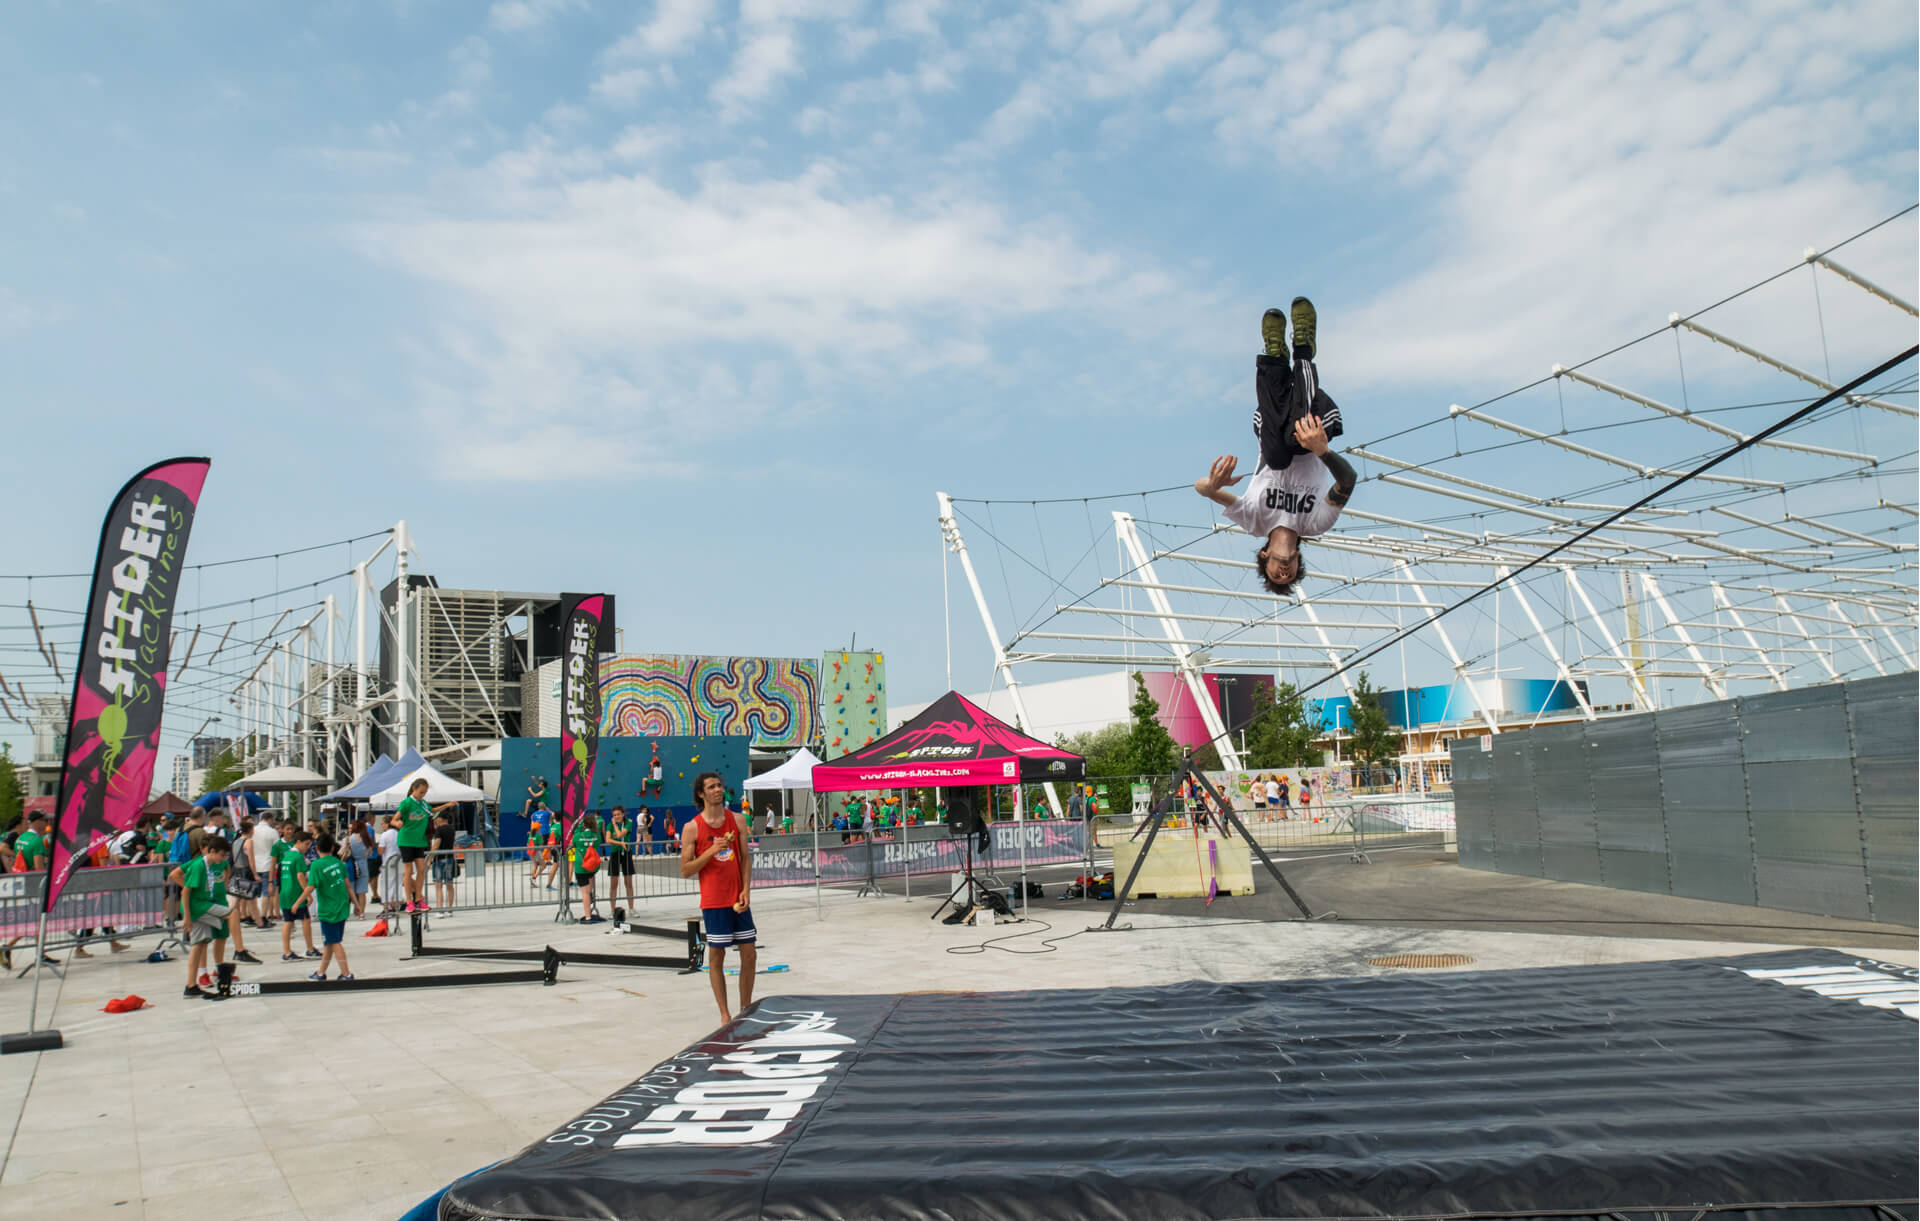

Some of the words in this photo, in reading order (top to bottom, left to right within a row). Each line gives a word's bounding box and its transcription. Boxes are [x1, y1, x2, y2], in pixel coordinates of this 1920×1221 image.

[1266, 488, 1317, 514] SPIDER
[98, 500, 168, 698] SPIDER
[129, 505, 184, 704] slacklines
[566, 622, 590, 735] SPIDER
[230, 983, 261, 996] SPIDER
[612, 1049, 846, 1149] SPIDER
